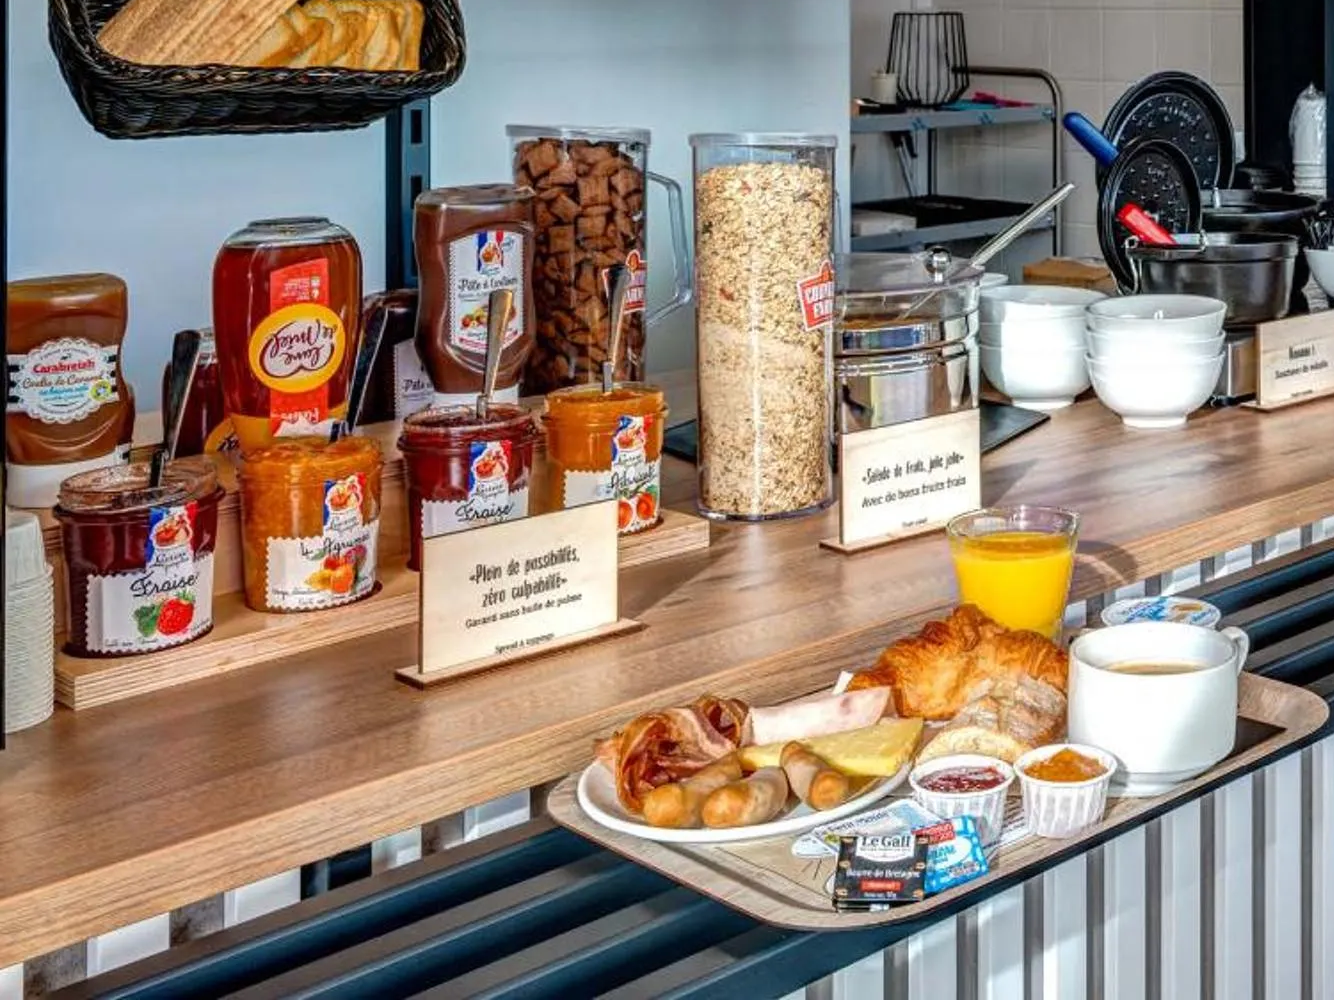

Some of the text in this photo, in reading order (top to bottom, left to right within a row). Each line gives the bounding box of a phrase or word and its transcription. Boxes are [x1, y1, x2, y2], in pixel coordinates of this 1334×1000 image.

[885, 491, 897, 502] de
[455, 499, 515, 522] Fraise
[507, 558, 520, 577] de
[130, 571, 199, 597] Fraise
[482, 587, 506, 608] zéro
[499, 608, 520, 621] sans
[521, 602, 542, 615] huile
[545, 599, 556, 609] de
[557, 593, 582, 608] palme
[862, 835, 880, 847] Le
